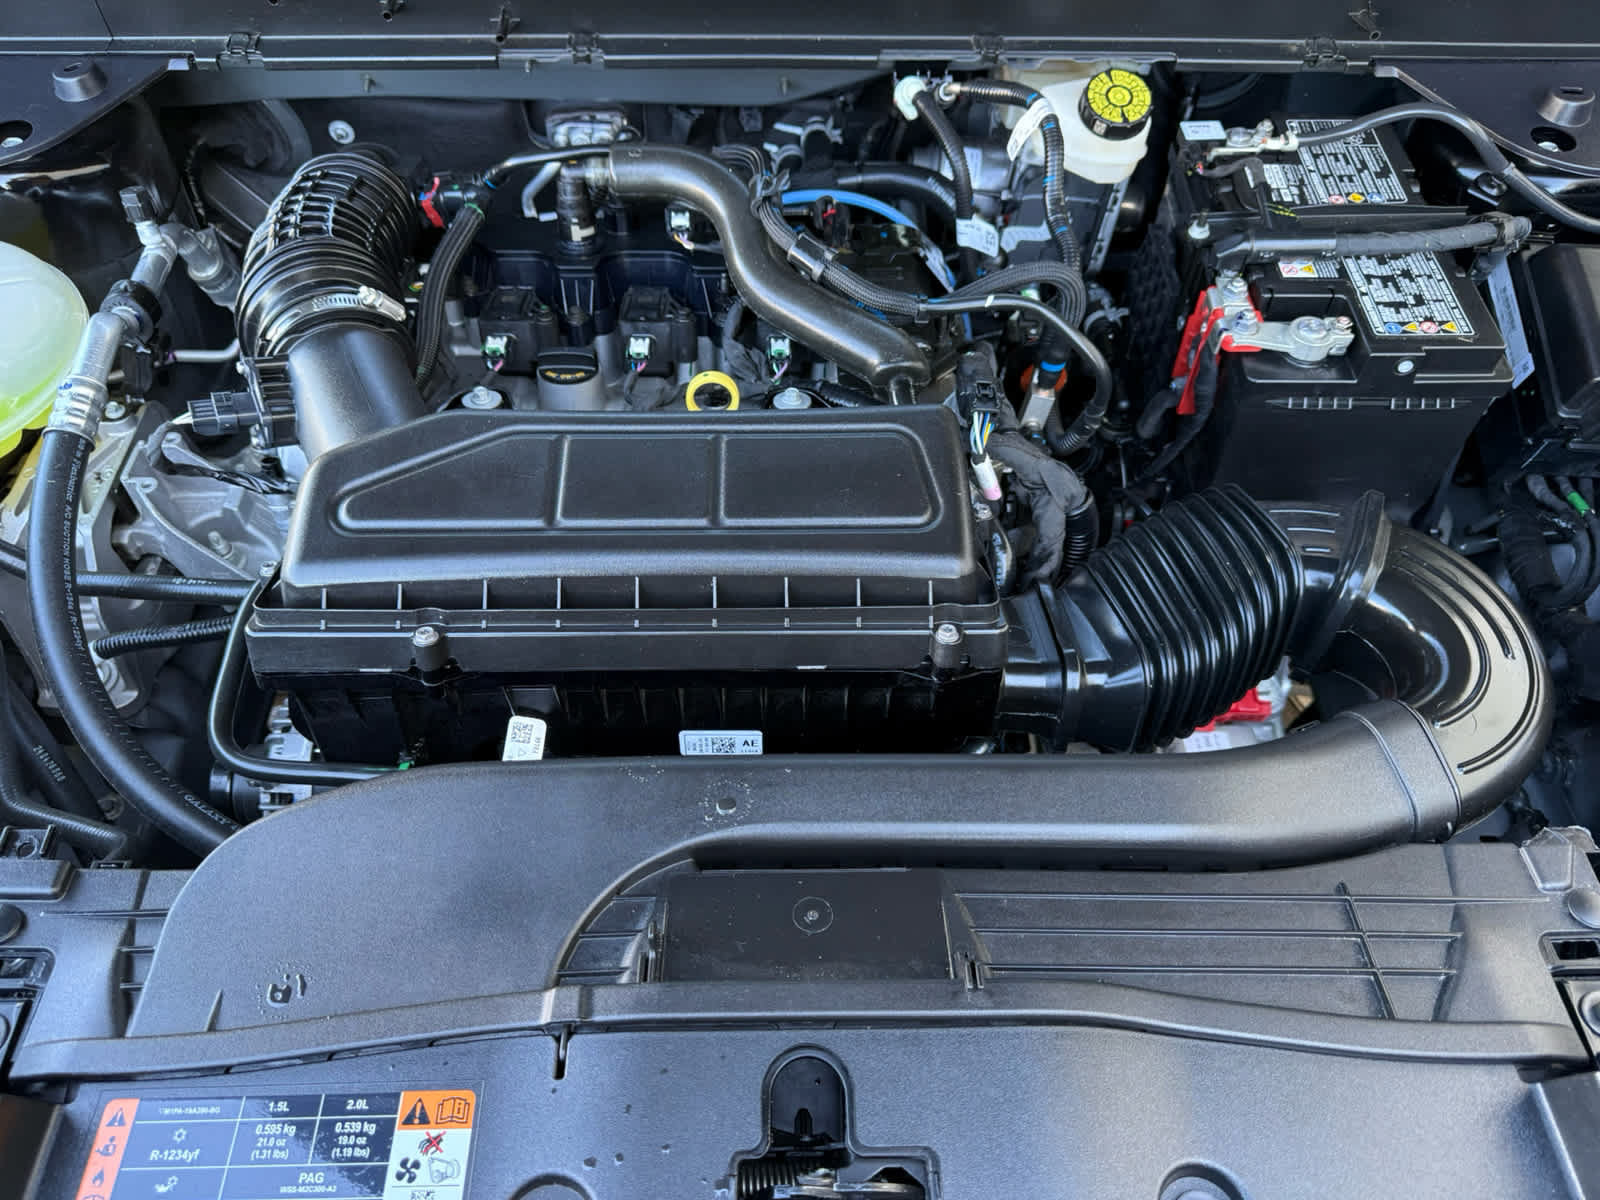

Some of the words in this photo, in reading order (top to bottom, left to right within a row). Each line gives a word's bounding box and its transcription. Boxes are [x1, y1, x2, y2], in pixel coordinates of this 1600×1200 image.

[63, 520, 72, 556] SUCTION
[63, 557, 72, 580] HOSE
[743, 739, 760, 747] AE
[268, 1101, 290, 1112] 1.5L
[346, 1099, 369, 1110] 2.0L
[255, 1124, 282, 1135] 0.595
[282, 1123, 296, 1136] kg
[335, 1122, 362, 1134] 0.539
[363, 1122, 376, 1135] kg
[257, 1137, 275, 1147] 21.0
[275, 1138, 287, 1146] oz
[338, 1136, 355, 1145] 19.0
[150, 1148, 201, 1163] R-1234yf
[251, 1149, 271, 1160] (1.31
[272, 1148, 289, 1159] lbs)
[331, 1147, 352, 1159] (1.19
[353, 1146, 370, 1158] lbs)
[298, 1172, 324, 1184] PAG
